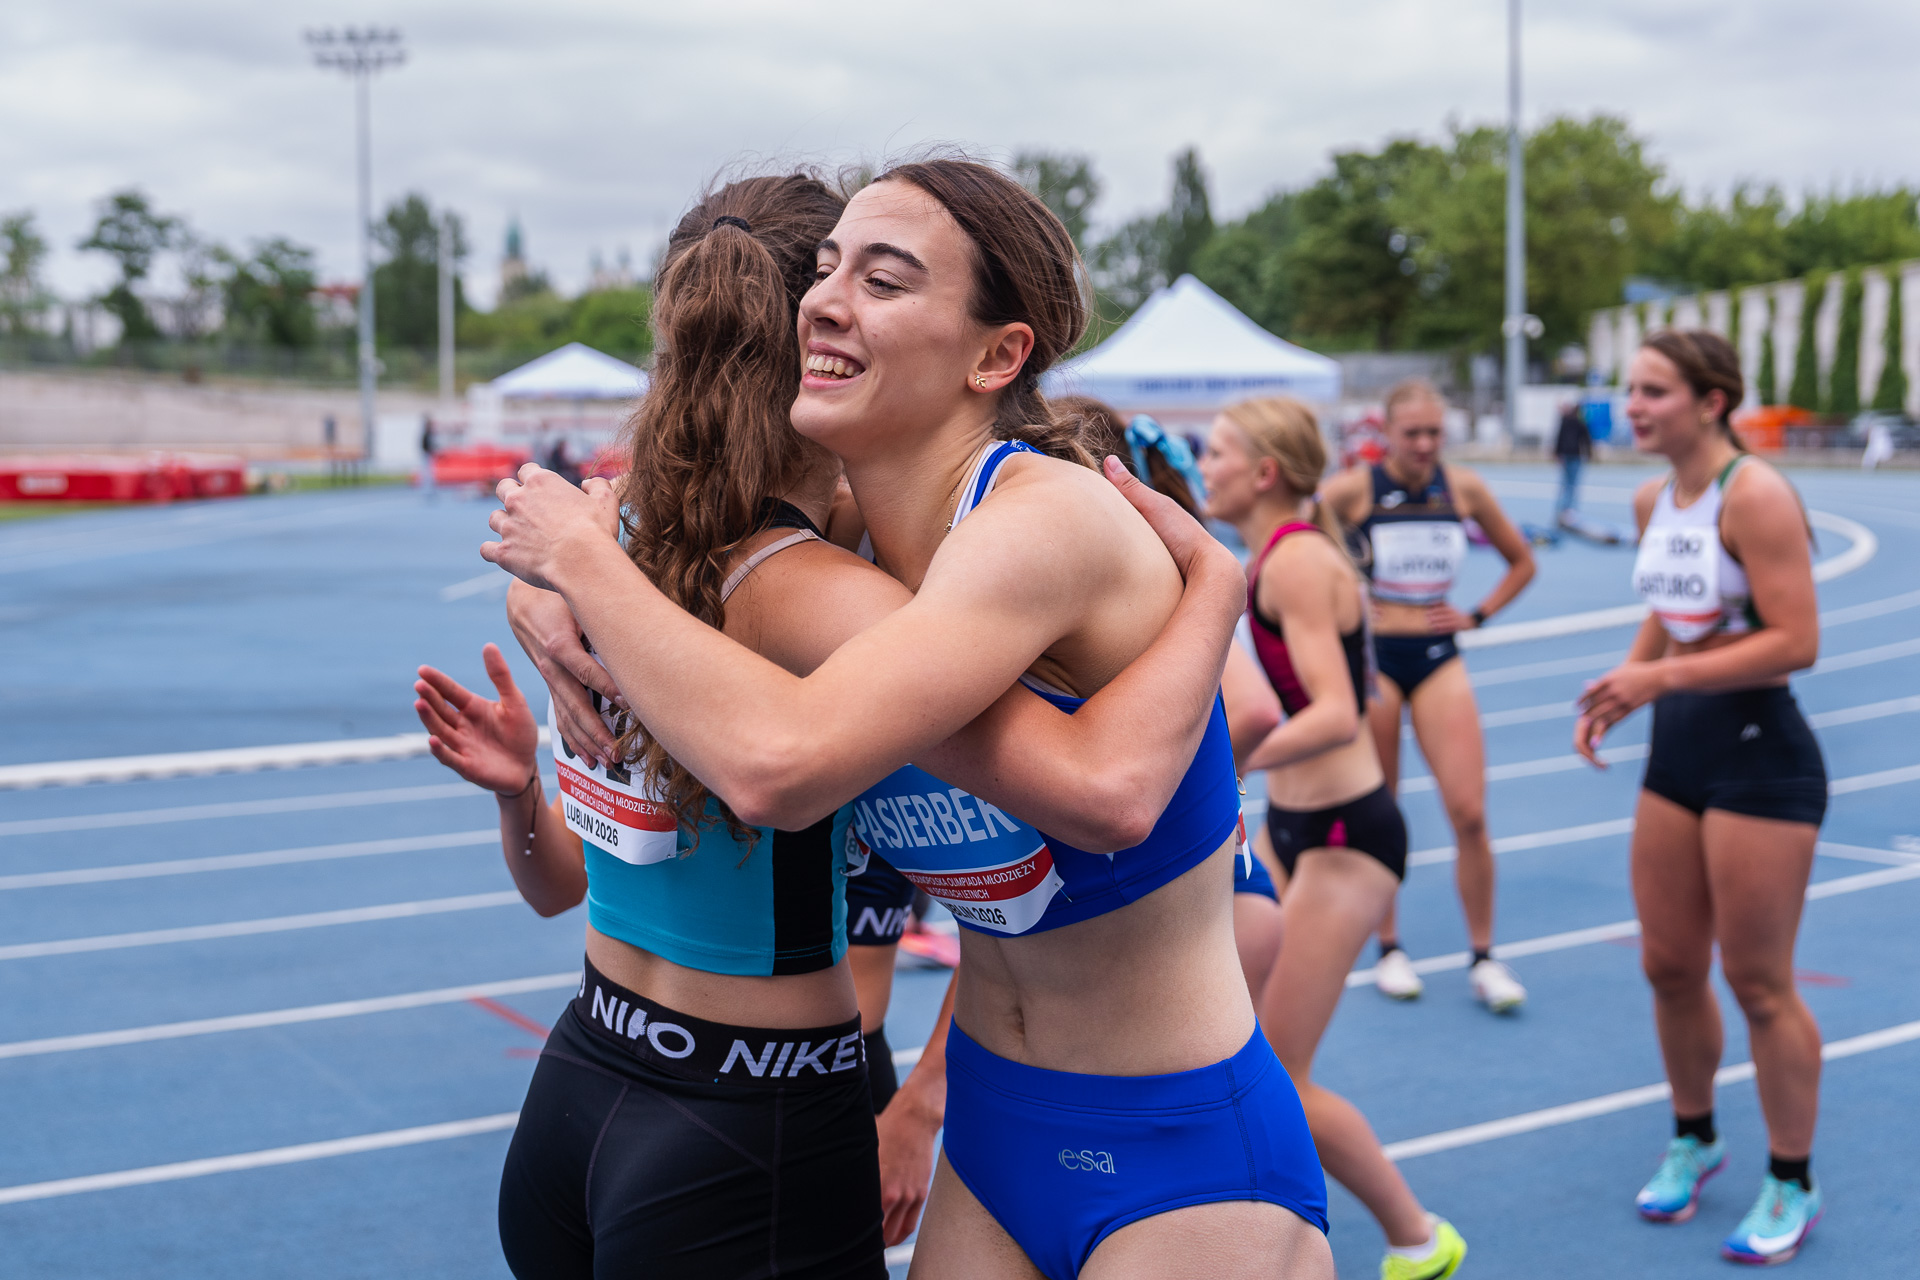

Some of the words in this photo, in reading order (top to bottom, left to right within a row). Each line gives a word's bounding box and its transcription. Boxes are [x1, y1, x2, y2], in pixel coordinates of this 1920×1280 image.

[574, 785, 596, 808] SPORTACH
[595, 798, 615, 818] LETNICH
[591, 783, 615, 803] OLIMPIADA
[616, 795, 658, 816] MŁODZIEŻY
[566, 802, 594, 834] LUBLIN
[595, 819, 619, 847] 2026
[947, 874, 982, 888] OLIMPIADA
[983, 861, 1037, 886] MŁODZIEŻY
[960, 889, 990, 900] LETNICH
[972, 907, 1007, 926] 2026
[719, 1031, 860, 1078] NIKE
